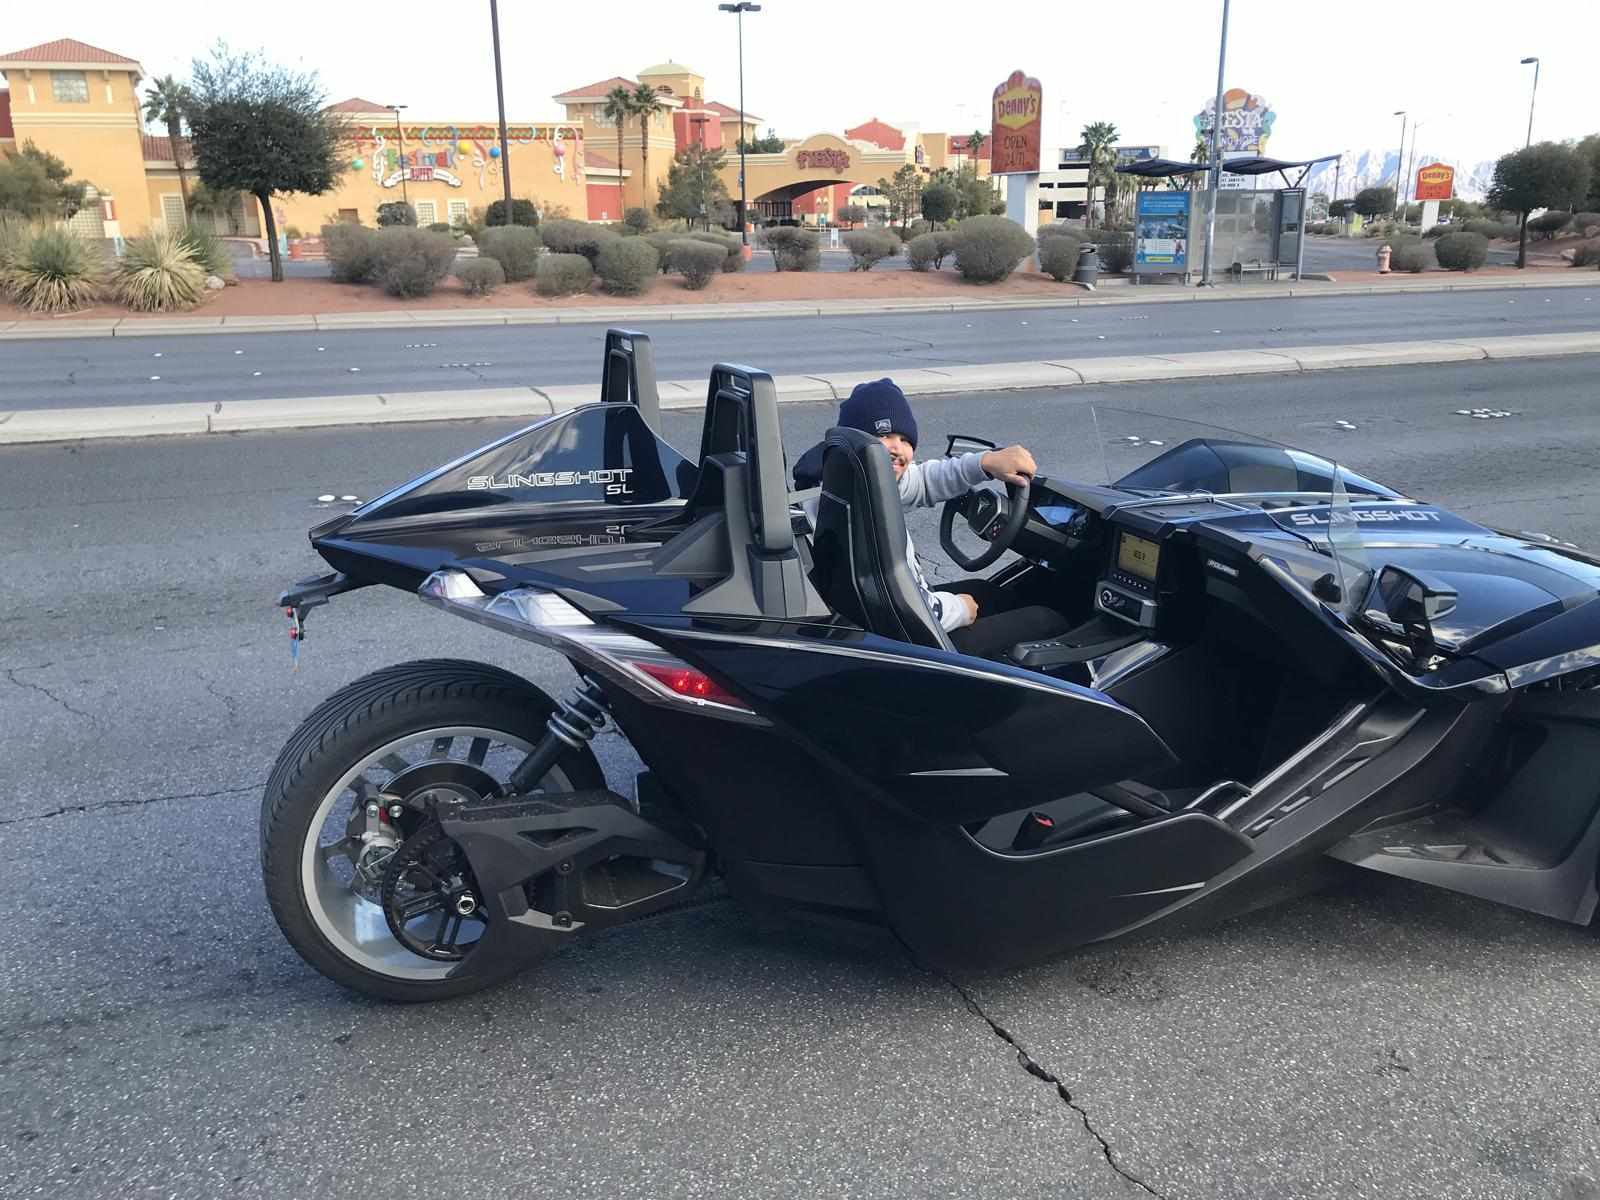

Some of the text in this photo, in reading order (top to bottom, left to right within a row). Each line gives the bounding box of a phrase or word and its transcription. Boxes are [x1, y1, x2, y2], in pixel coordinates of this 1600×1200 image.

[998, 94, 1037, 117] Denny's
[1207, 108, 1264, 129] FESTA
[1004, 135, 1028, 150] OPEN
[467, 468, 633, 490] SLINGSHOT
[606, 483, 634, 495] SL
[1290, 510, 1440, 526] SLINGSHOT
